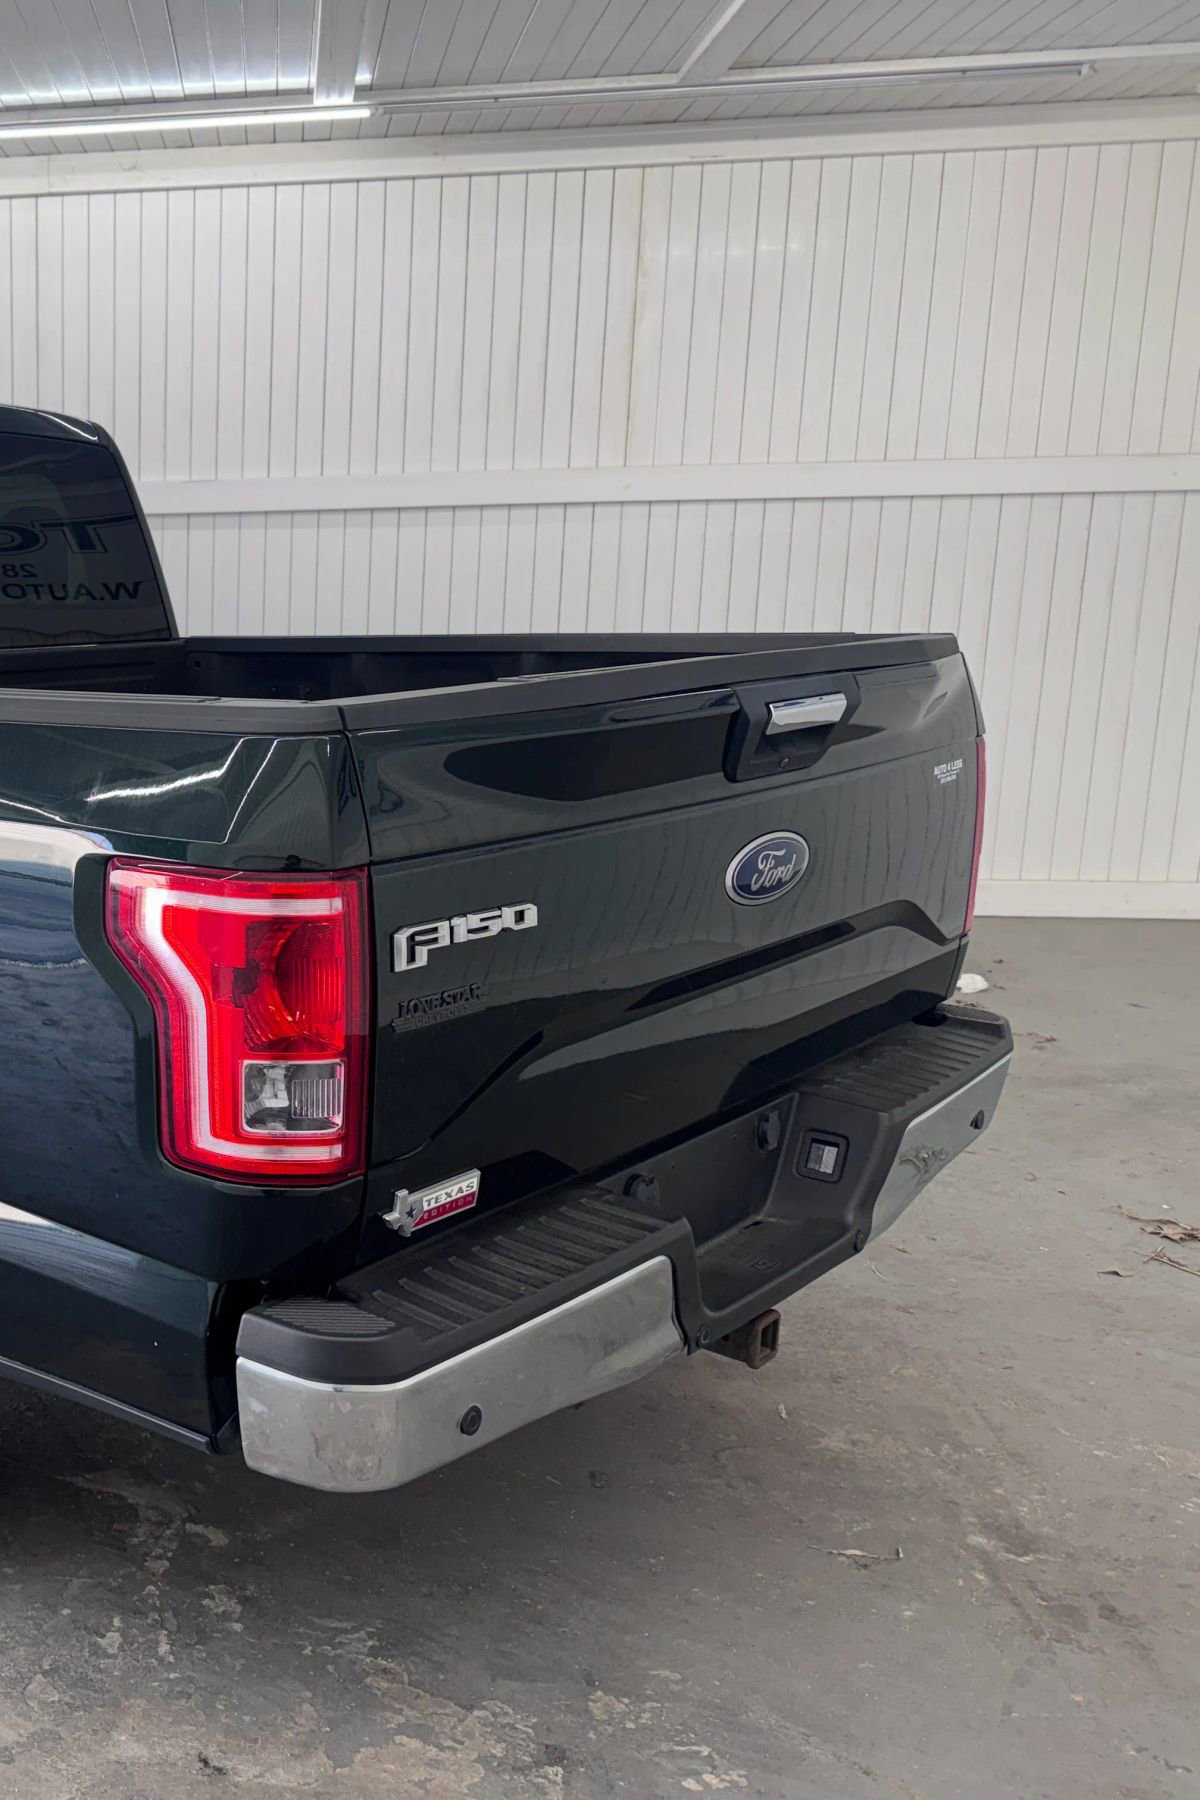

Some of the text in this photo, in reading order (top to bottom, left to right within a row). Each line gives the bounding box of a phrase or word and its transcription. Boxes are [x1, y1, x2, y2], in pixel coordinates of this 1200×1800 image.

[750, 848, 797, 892] Ford
[423, 1194, 474, 1220] EDITION
[424, 1181, 476, 1207] TEXAS
